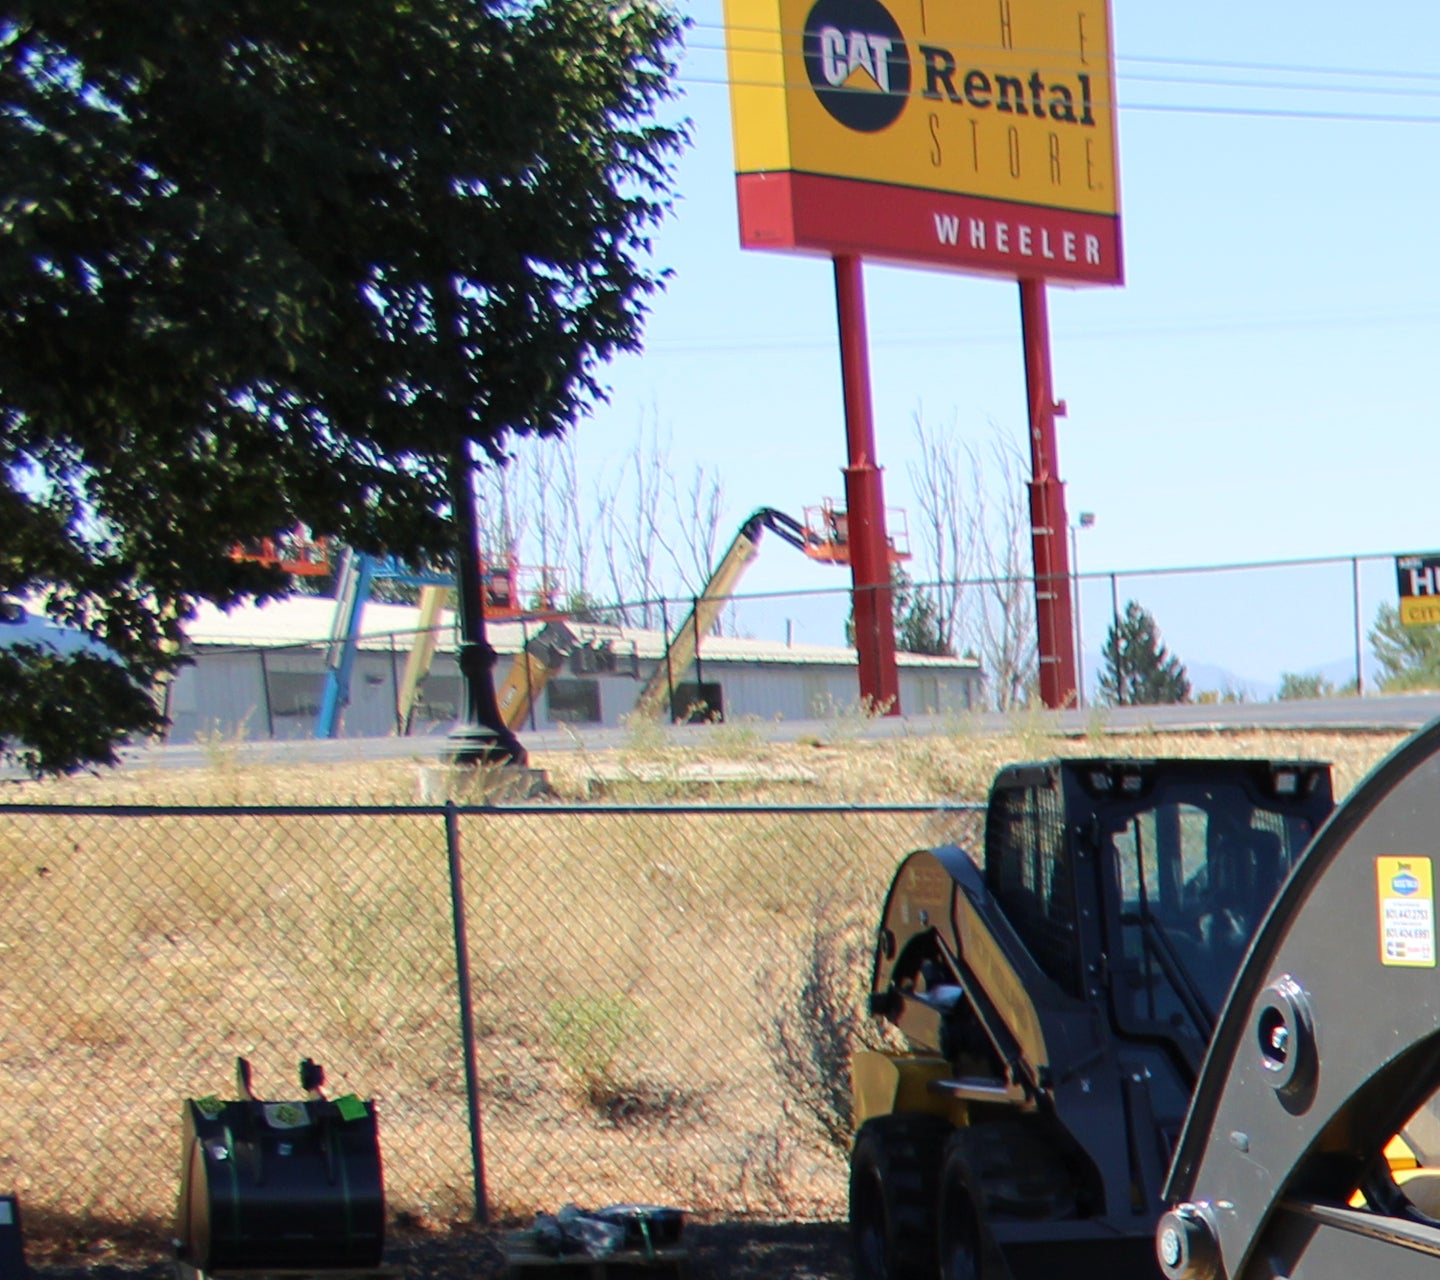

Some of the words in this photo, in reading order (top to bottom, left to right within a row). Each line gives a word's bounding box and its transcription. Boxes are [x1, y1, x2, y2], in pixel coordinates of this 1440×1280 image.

[820, 26, 892, 93] CAT
[919, 44, 1096, 127] Rental
[928, 114, 1098, 190] STORE
[934, 212, 1101, 265] WHEELER
